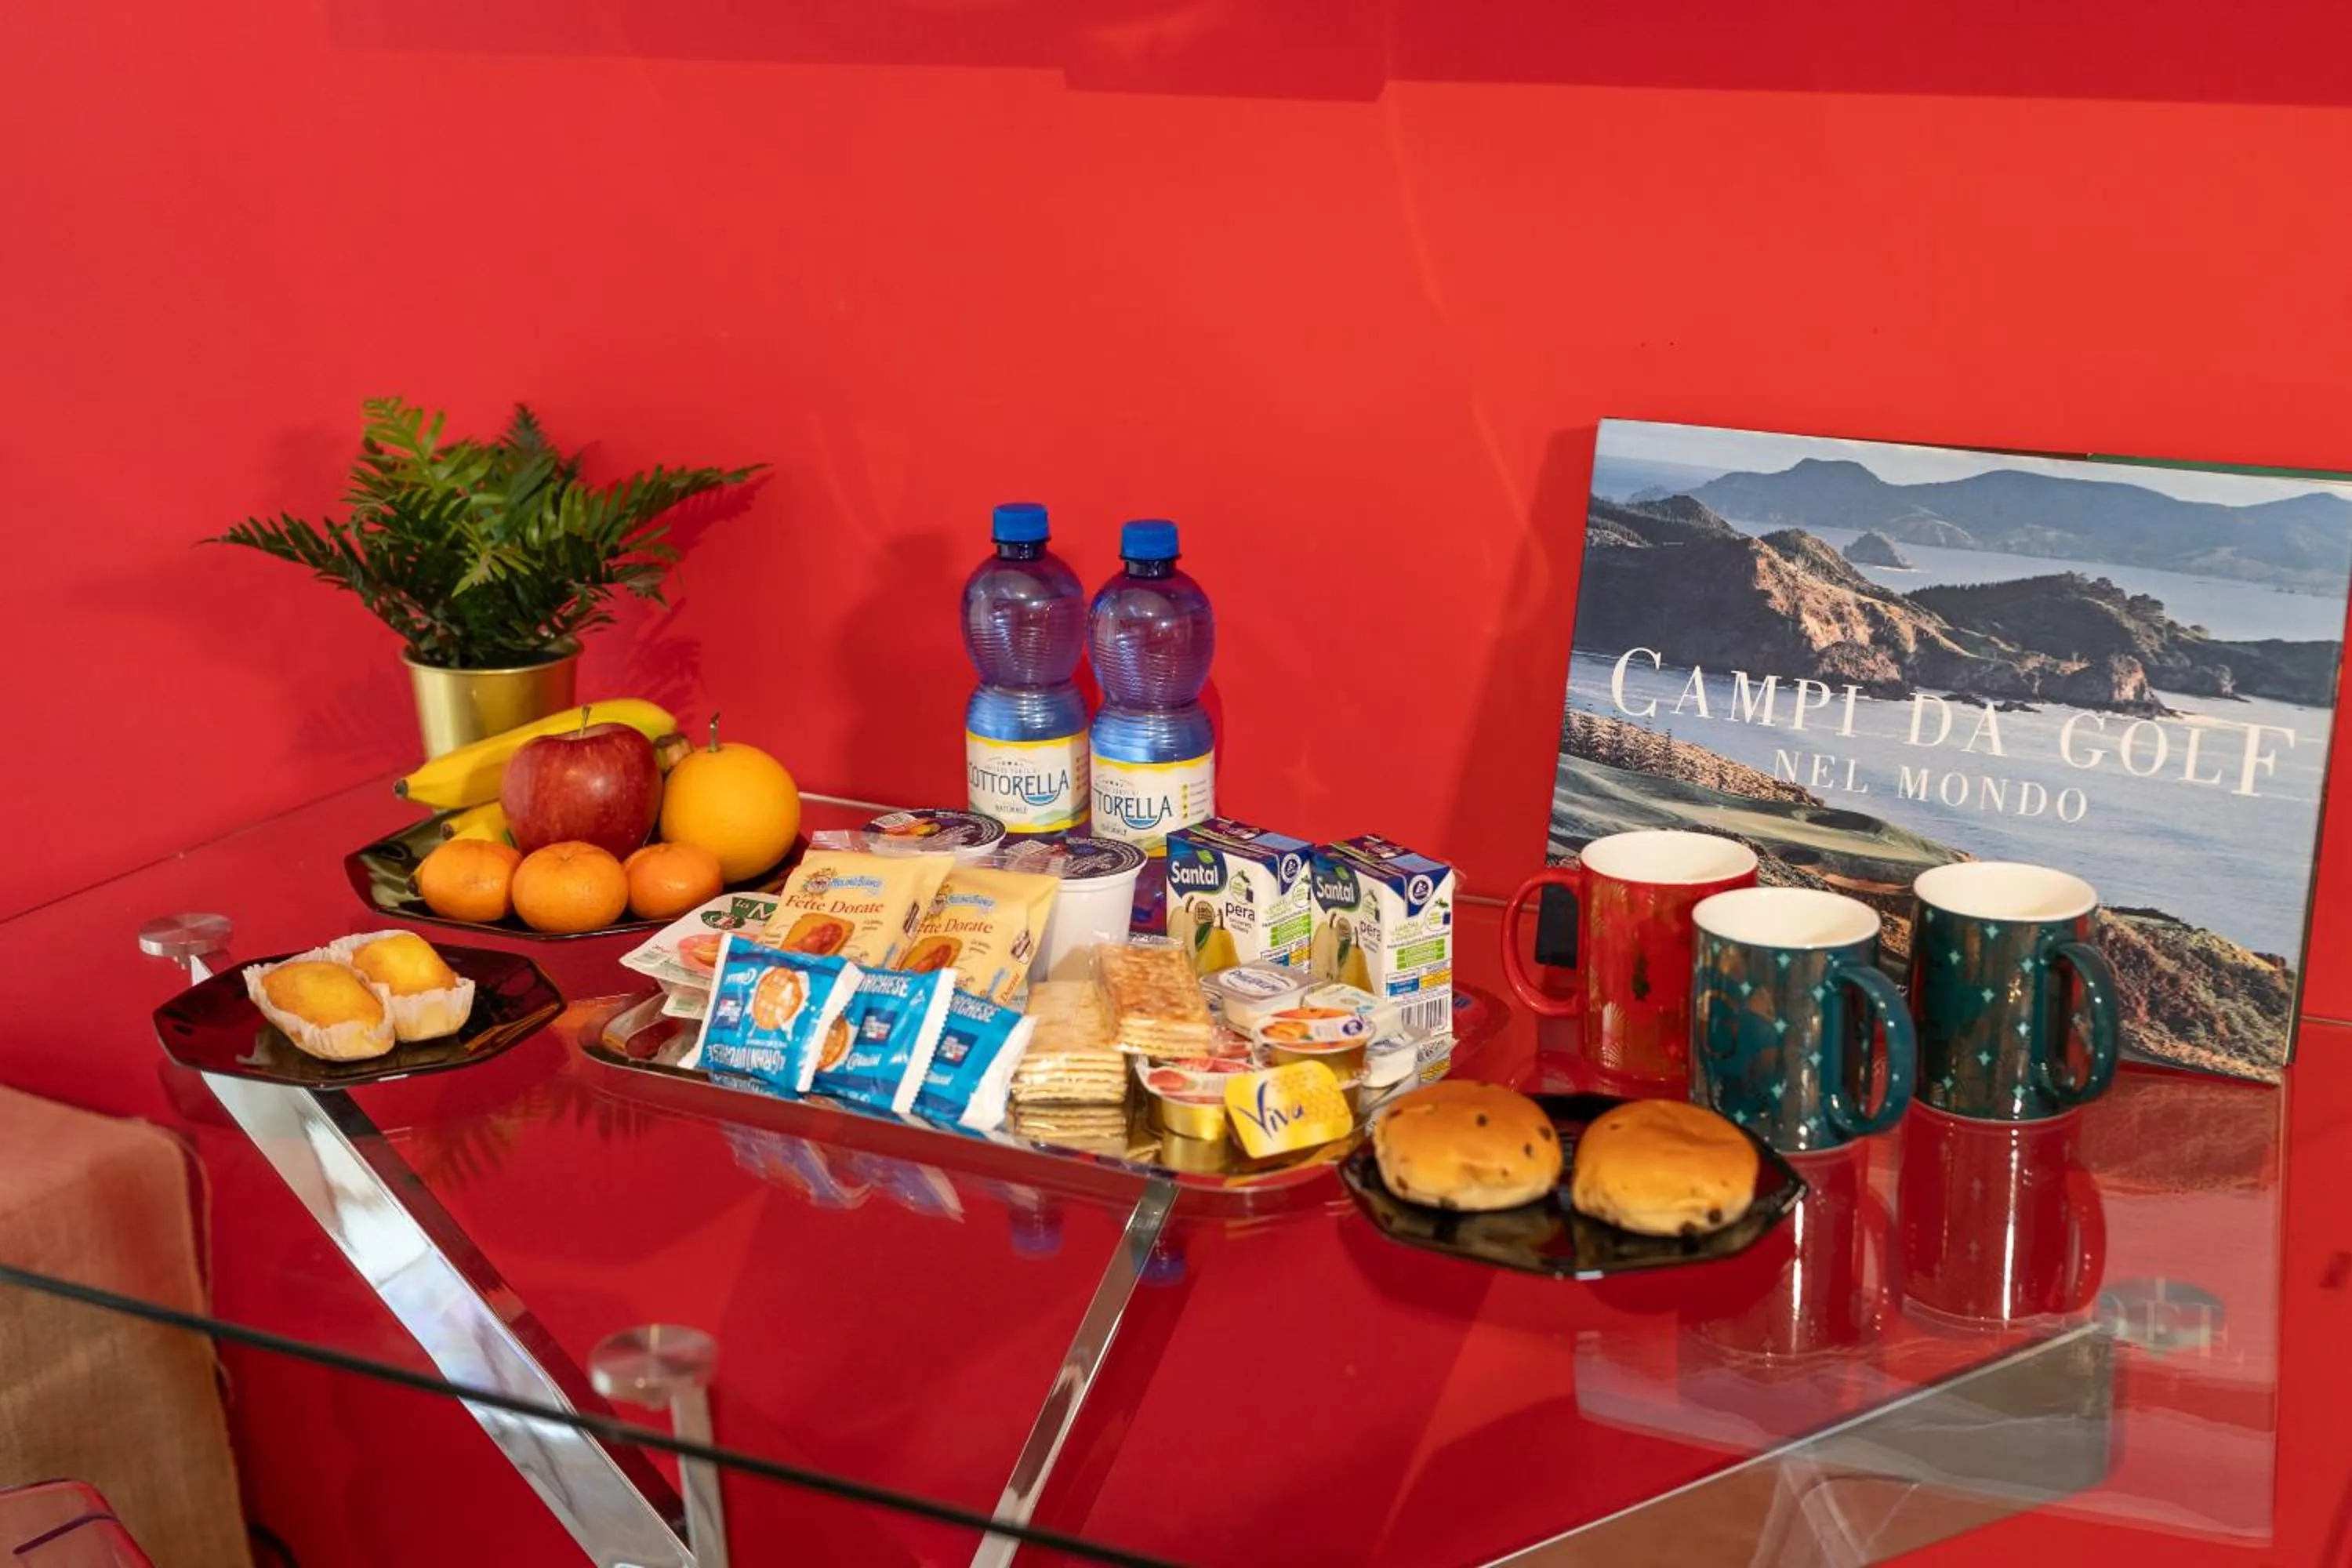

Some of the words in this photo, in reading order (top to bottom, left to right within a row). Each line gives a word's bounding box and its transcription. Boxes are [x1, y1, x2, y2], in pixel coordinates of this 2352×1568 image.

[1611, 647, 1864, 738] CAMPI
[1903, 691, 2008, 756] DA
[2059, 712, 2296, 797] GOLF
[1773, 749, 1868, 794] NEL
[1896, 764, 2088, 823] MONDO
[1171, 860, 1220, 887] Santal
[1316, 875, 1356, 904] Santal
[785, 894, 826, 912] Fette
[829, 900, 887, 914] Dorate
[1225, 902, 1256, 922] pera
[943, 918, 993, 934] Dorate
[1359, 920, 1382, 941] pera
[1234, 1080, 1306, 1142] Viva
